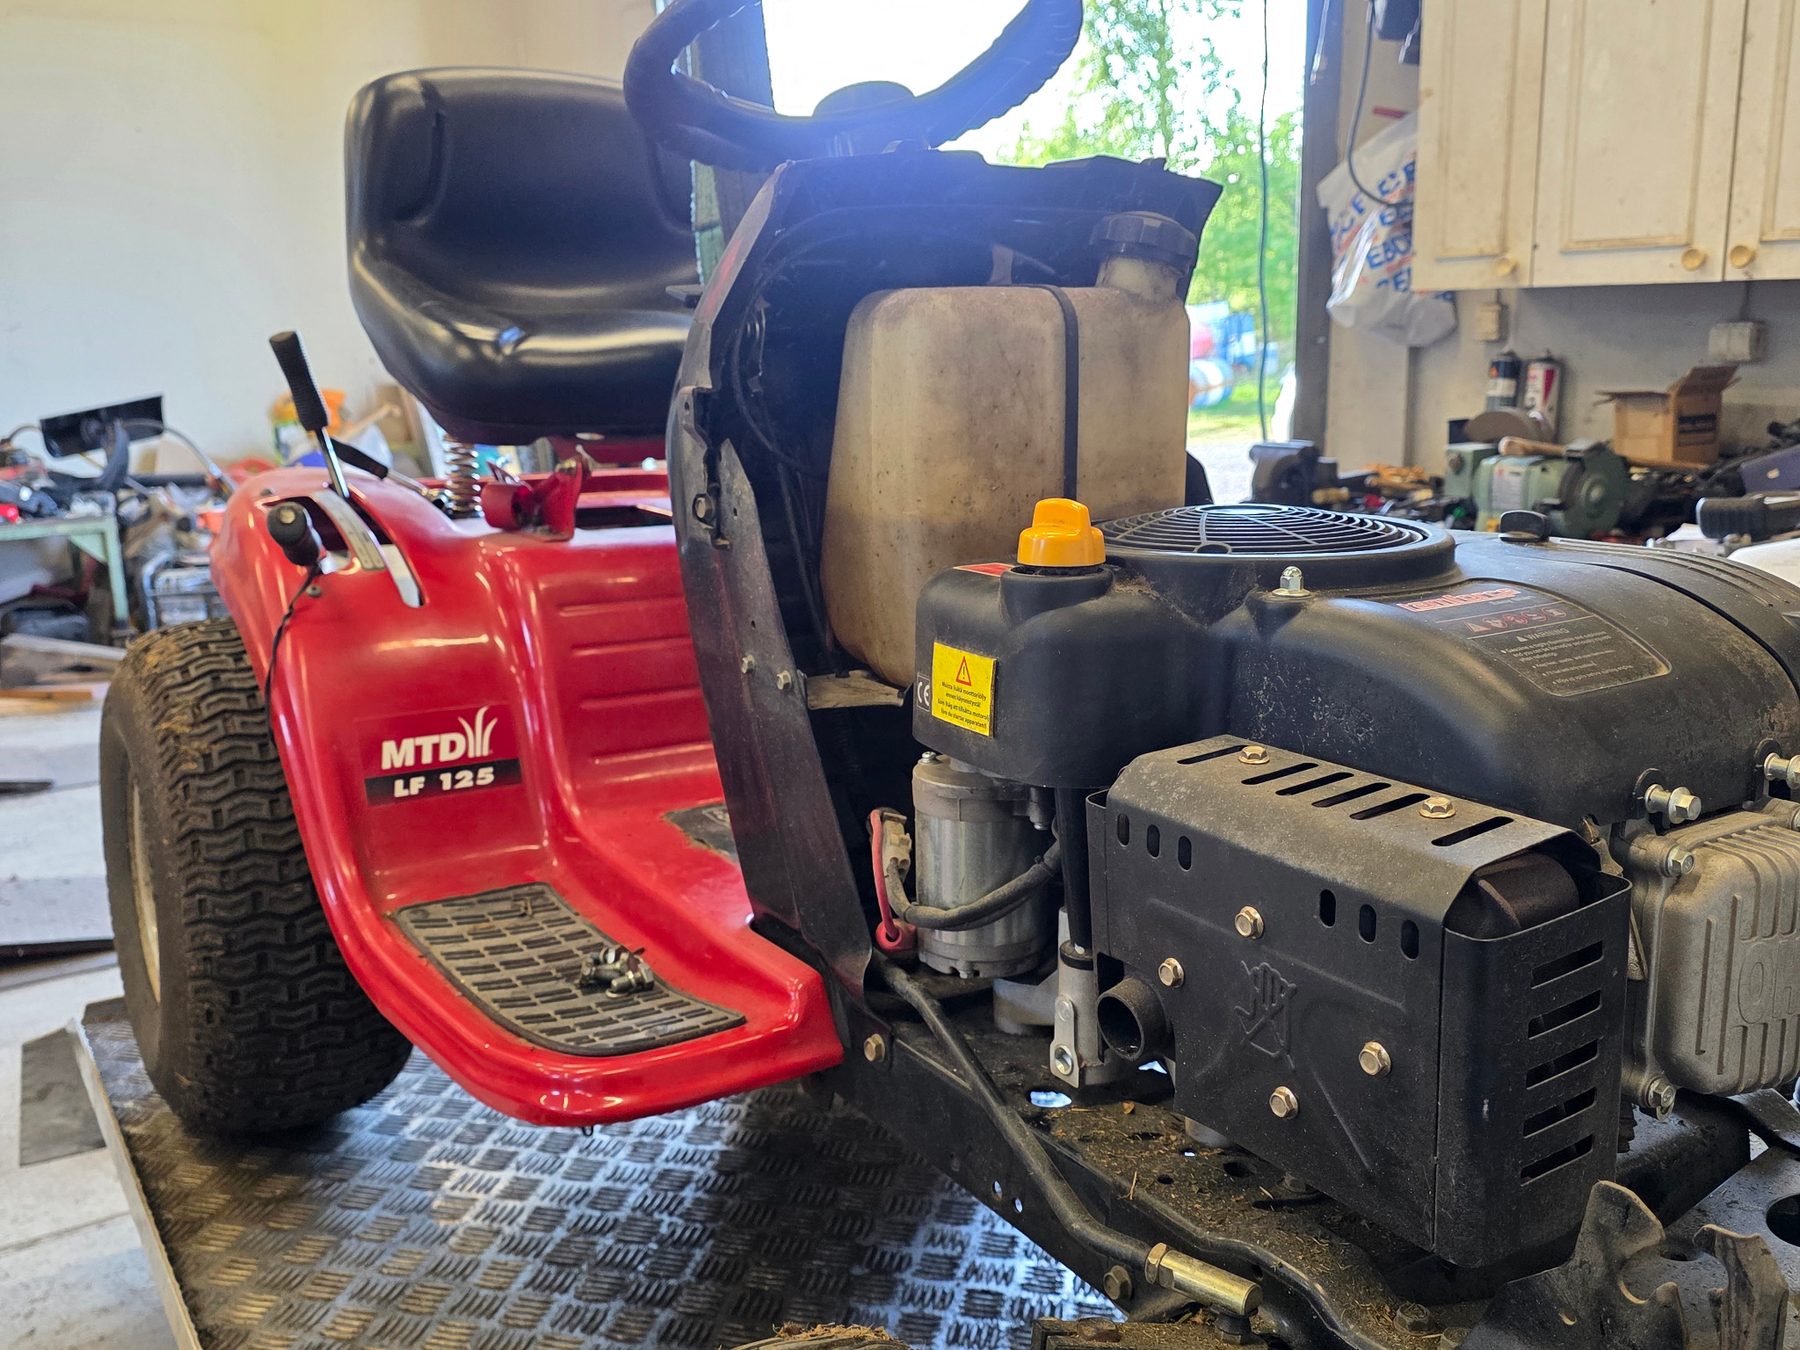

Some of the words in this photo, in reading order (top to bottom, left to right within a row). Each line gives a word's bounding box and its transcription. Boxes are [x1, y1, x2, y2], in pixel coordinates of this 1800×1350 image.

[381, 731, 467, 770] MTD
[394, 776, 425, 798] LF
[439, 766, 495, 791] 125
